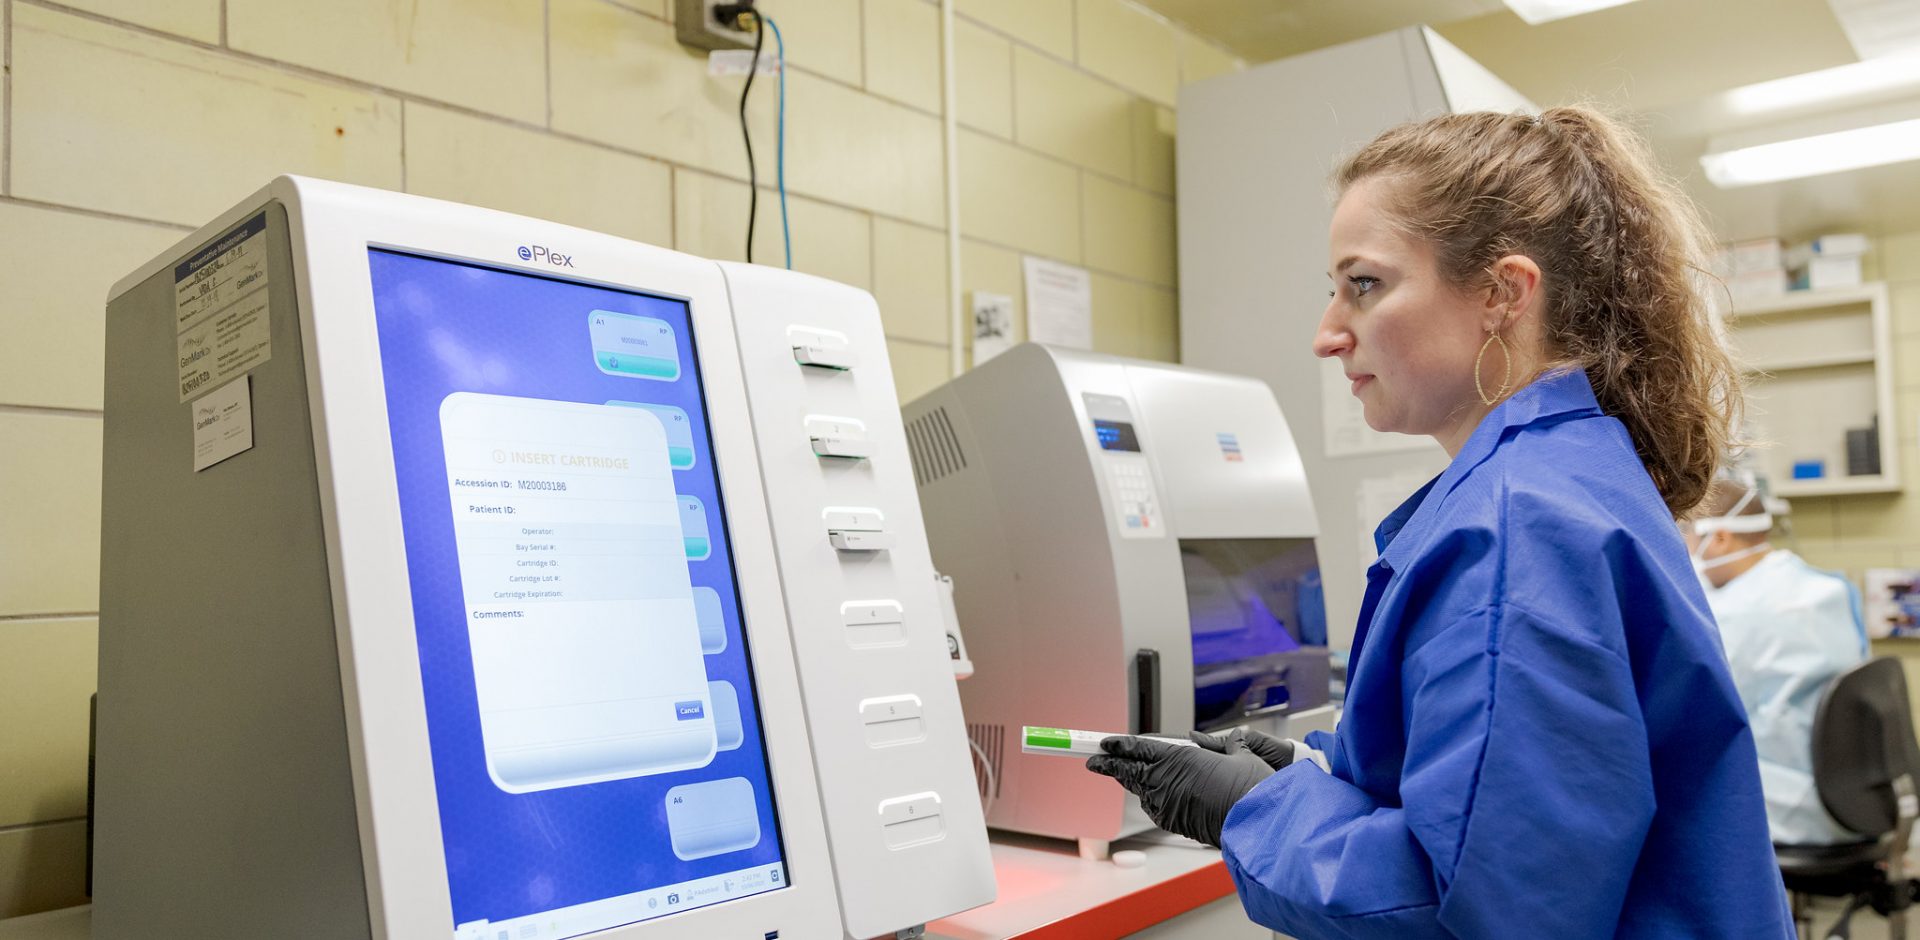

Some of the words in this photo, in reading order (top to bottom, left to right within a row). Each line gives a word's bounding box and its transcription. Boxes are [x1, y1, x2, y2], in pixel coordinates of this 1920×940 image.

[518, 245, 574, 268] ePlex
[596, 318, 605, 326] A1
[511, 451, 556, 465] INSERT
[560, 455, 630, 469] CARTRIDGE
[455, 479, 499, 488] Accession
[501, 481, 513, 489] ID:
[469, 505, 502, 514] Patient
[504, 506, 517, 514] ID:
[521, 528, 555, 536] Operator:
[515, 544, 529, 552] Bay
[516, 560, 548, 568] Cartridge
[509, 575, 541, 583] Cartridge
[493, 591, 526, 600] Cartridge
[527, 590, 564, 598] Expiration:
[472, 610, 525, 619] Comments:
[680, 705, 700, 715] Cancel
[673, 796, 683, 805] A6
